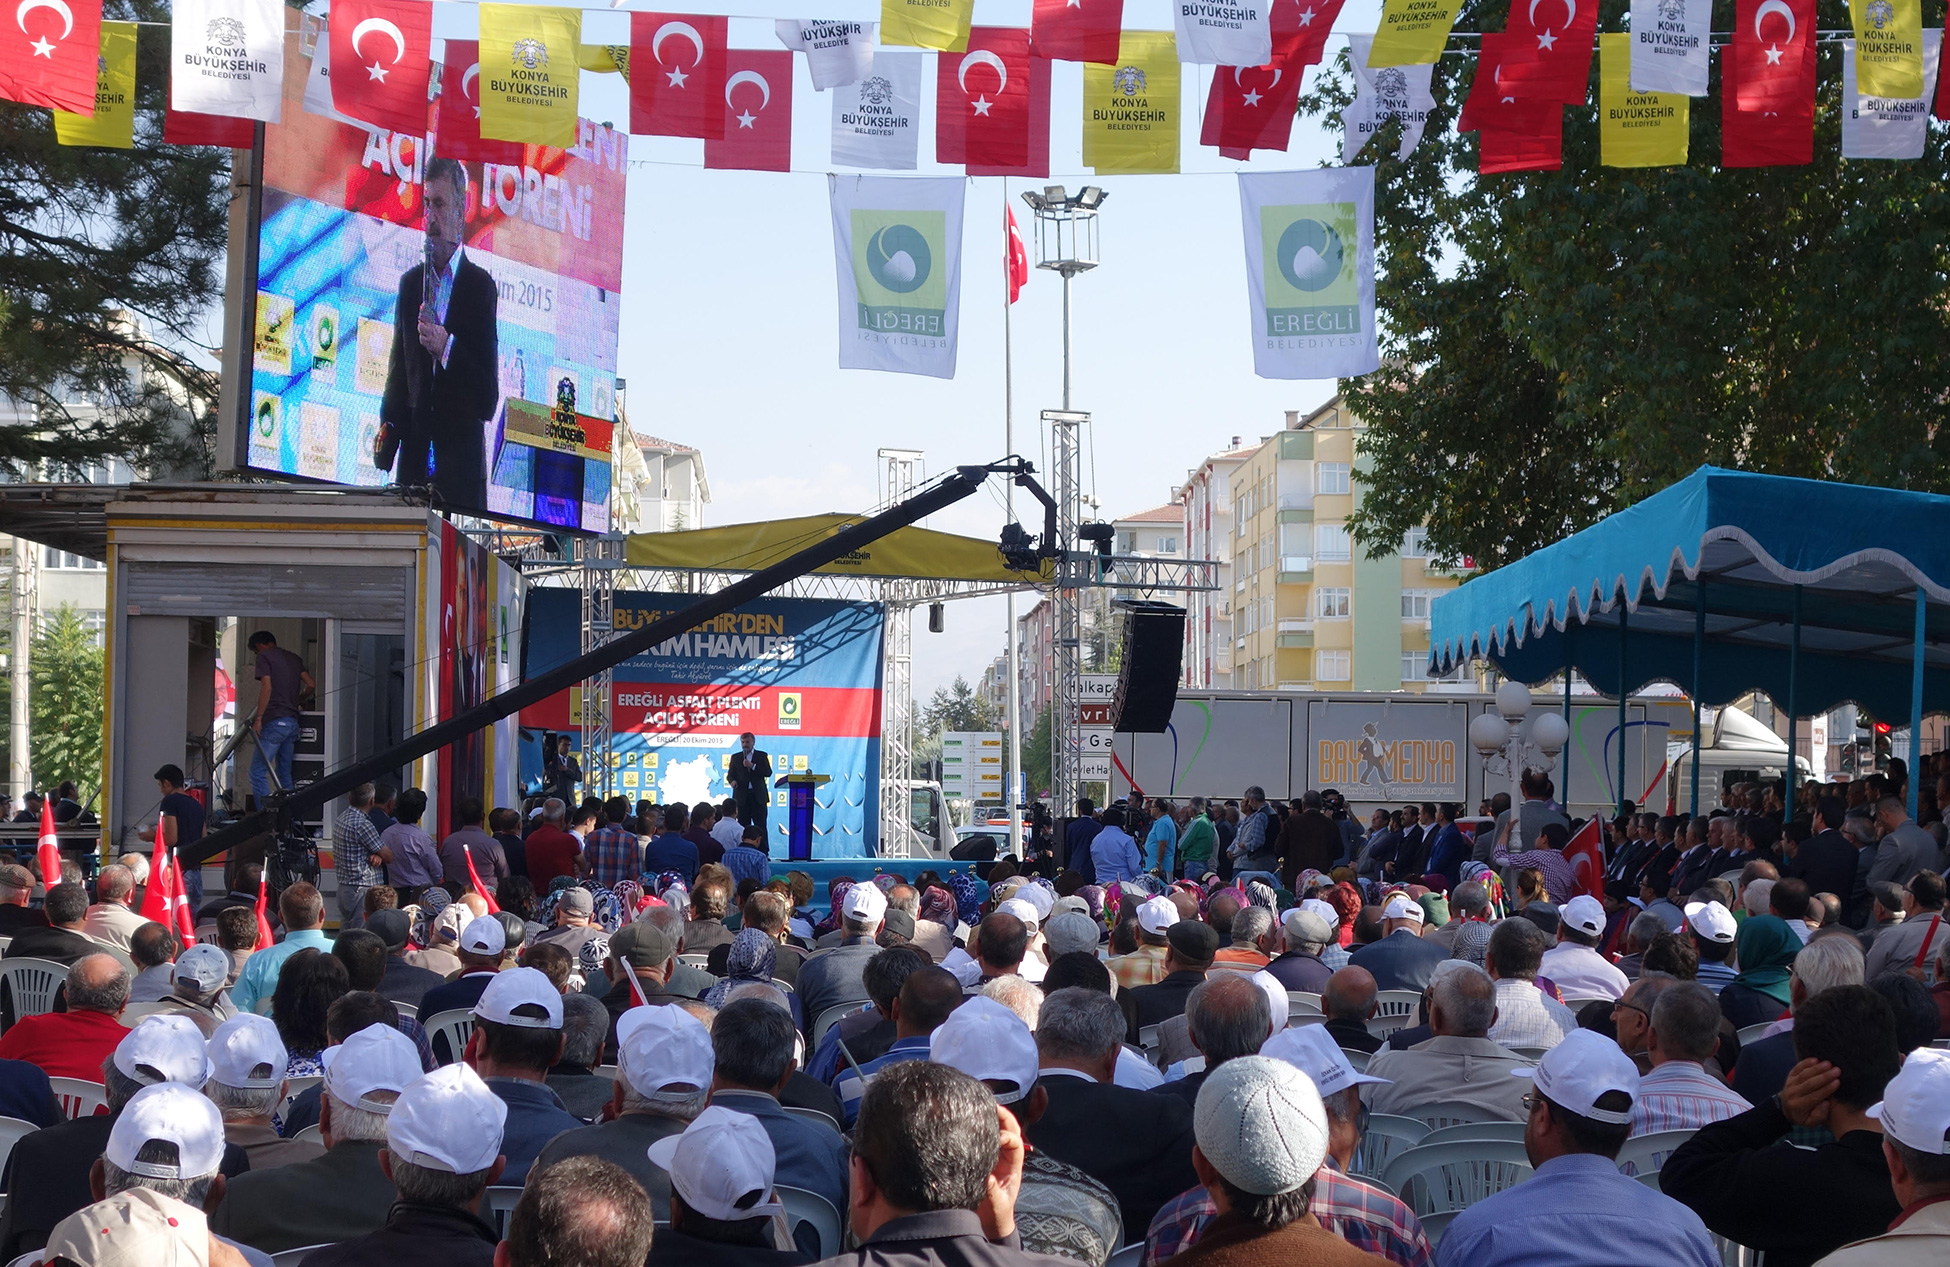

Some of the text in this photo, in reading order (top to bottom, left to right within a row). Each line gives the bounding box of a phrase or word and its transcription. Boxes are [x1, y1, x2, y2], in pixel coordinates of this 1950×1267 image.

[1182, 2, 1257, 21] BÜYÜKŞEHİR
[1406, 1, 1438, 11] KONYA
[1657, 21, 1686, 33] KONYA
[1640, 30, 1699, 48] BÜYÜKŞEHİR
[1864, 30, 1896, 40] KONYA
[206, 45, 247, 57] KONYA
[185, 54, 267, 74] BÜYÜKŞEHİR
[511, 69, 549, 83] KONYA
[490, 78, 568, 99] BÜYÜKŞEHİR
[1112, 98, 1148, 108] KONYA
[1626, 96, 1659, 106] KONYA
[1867, 99, 1926, 113] BÜYÜKŞEHİR
[859, 104, 893, 115] KONYA
[1093, 107, 1166, 124] BÜYÜKŞEHİR
[1610, 104, 1675, 120] BÜYÜKŞEHİR
[841, 113, 908, 129] BÜYÜKŞEHİR
[517, 281, 552, 312] 2015
[666, 694, 713, 709] ASFALT
[643, 711, 686, 728] AÇILIŞ
[691, 735, 708, 744] Ekim
[708, 737, 724, 745] 2015
[1318, 739, 1456, 784] BAY MEDYA
